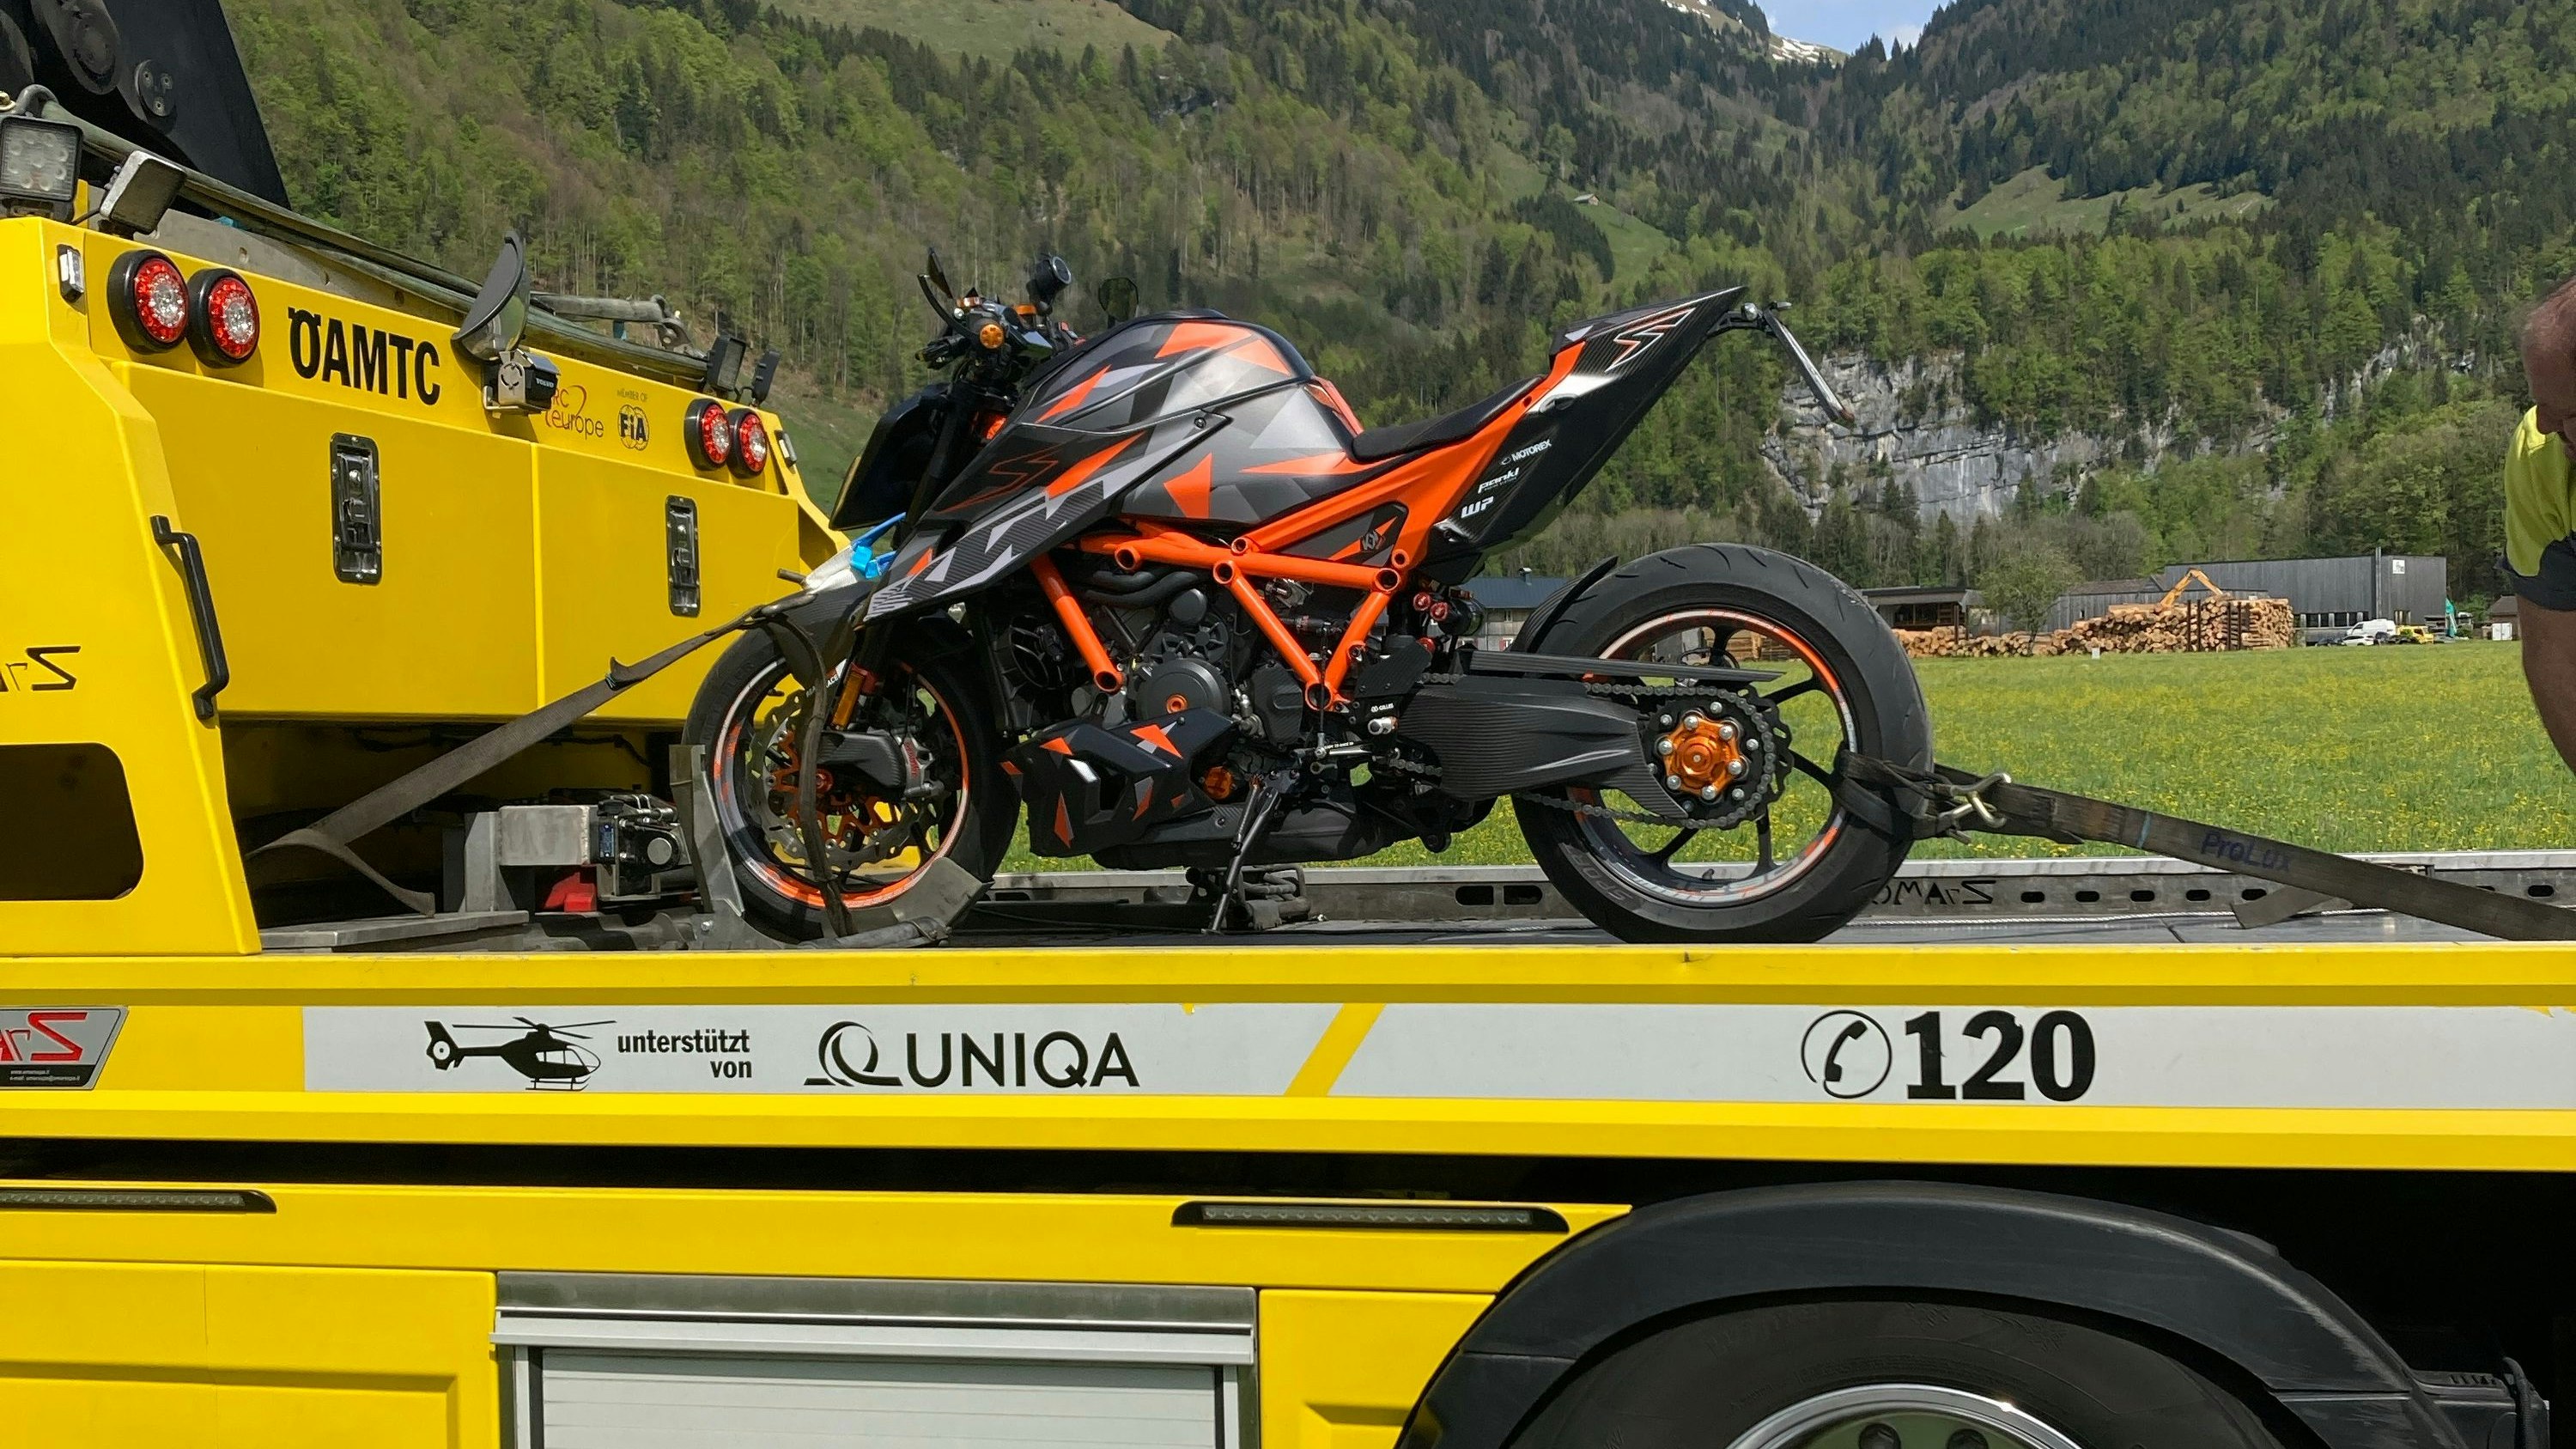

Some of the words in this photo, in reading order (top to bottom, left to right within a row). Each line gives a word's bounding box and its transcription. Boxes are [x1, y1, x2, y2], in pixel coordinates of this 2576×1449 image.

[288, 307, 440, 405] ÖAMTC
[551, 408, 605, 440] europe
[1511, 439, 1552, 461] MOTOREX
[617, 1028, 750, 1053] unterstützt
[1905, 1009, 2096, 1102] 120
[709, 1060, 753, 1079] von
[906, 1031, 1140, 1088] UNIQA
